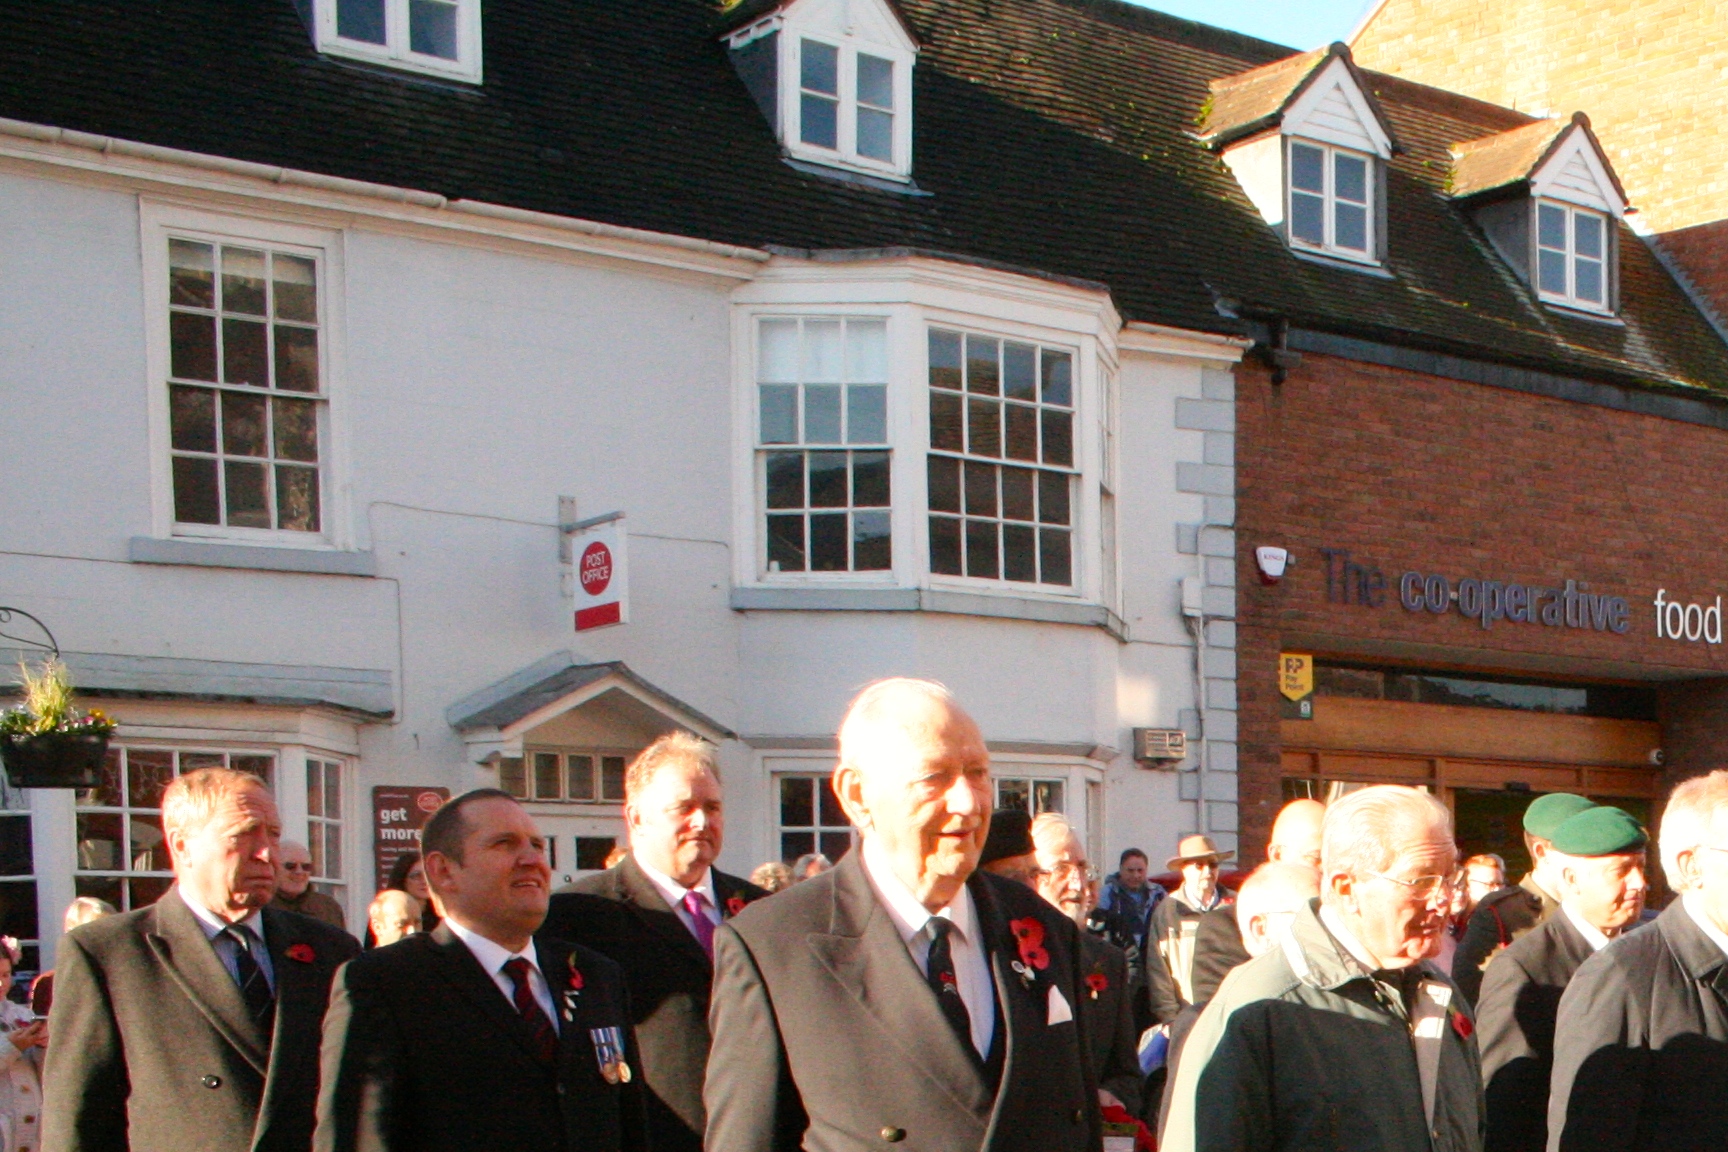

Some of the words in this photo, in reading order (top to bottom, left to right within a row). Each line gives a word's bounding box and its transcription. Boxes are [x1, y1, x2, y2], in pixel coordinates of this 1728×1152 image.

[586, 551, 607, 568] POST
[582, 566, 609, 584] OFFICE
[1321, 547, 1388, 607] The
[1400, 571, 1630, 633] co-operative
[1654, 589, 1722, 644] food
[381, 807, 408, 825] get
[380, 828, 422, 840] more
